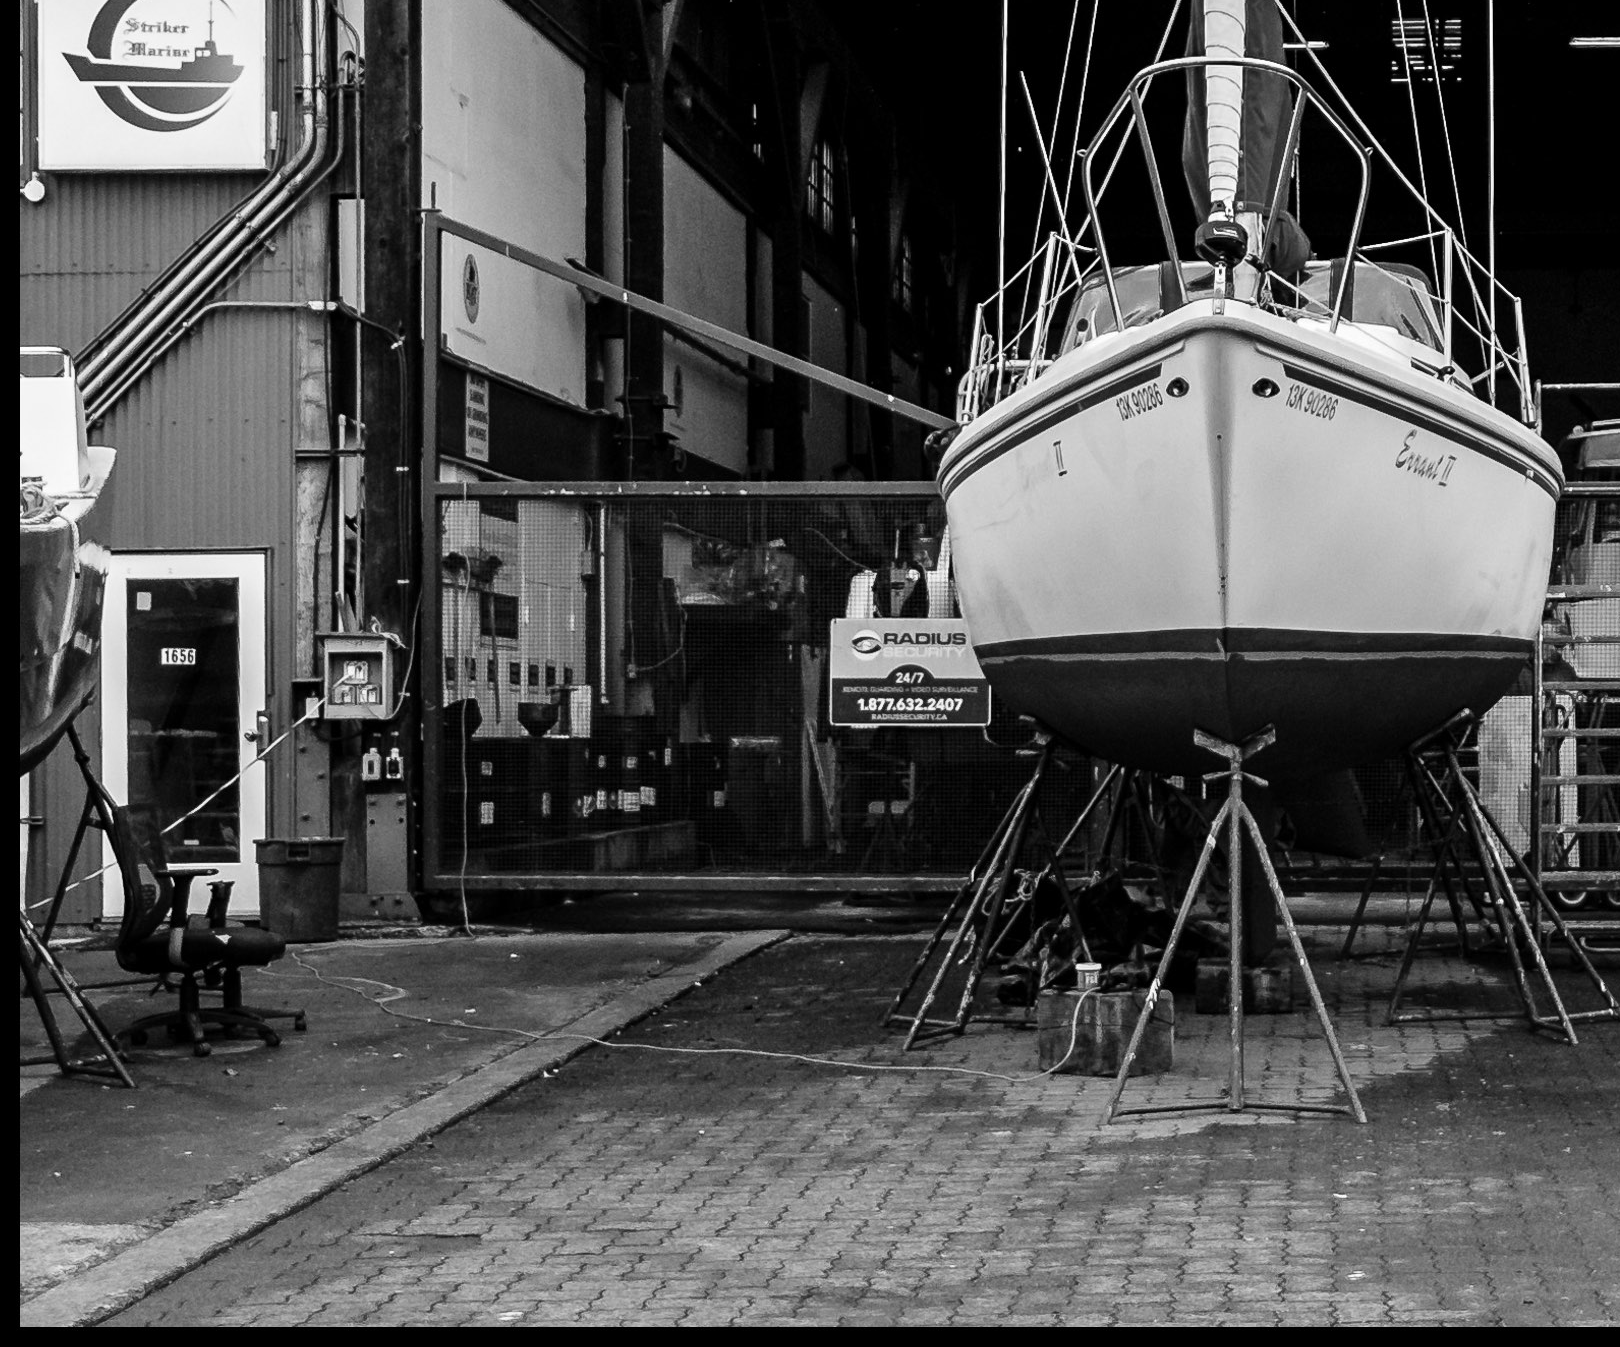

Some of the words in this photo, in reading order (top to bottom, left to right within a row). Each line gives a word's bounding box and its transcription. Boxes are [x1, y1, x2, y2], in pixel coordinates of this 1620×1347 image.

[123, 18, 189, 35] Striker
[122, 40, 190, 60] Marine
[1131, 383, 1164, 415] 90286
[1286, 383, 1308, 411] 13K
[1304, 389, 1339, 421] 90286
[883, 632, 967, 645] RADIUS
[165, 649, 195, 664] 1656
[883, 645, 966, 658] SECURITY
[895, 672, 925, 684] 24/7
[857, 697, 964, 711] 1.877.632.2407
